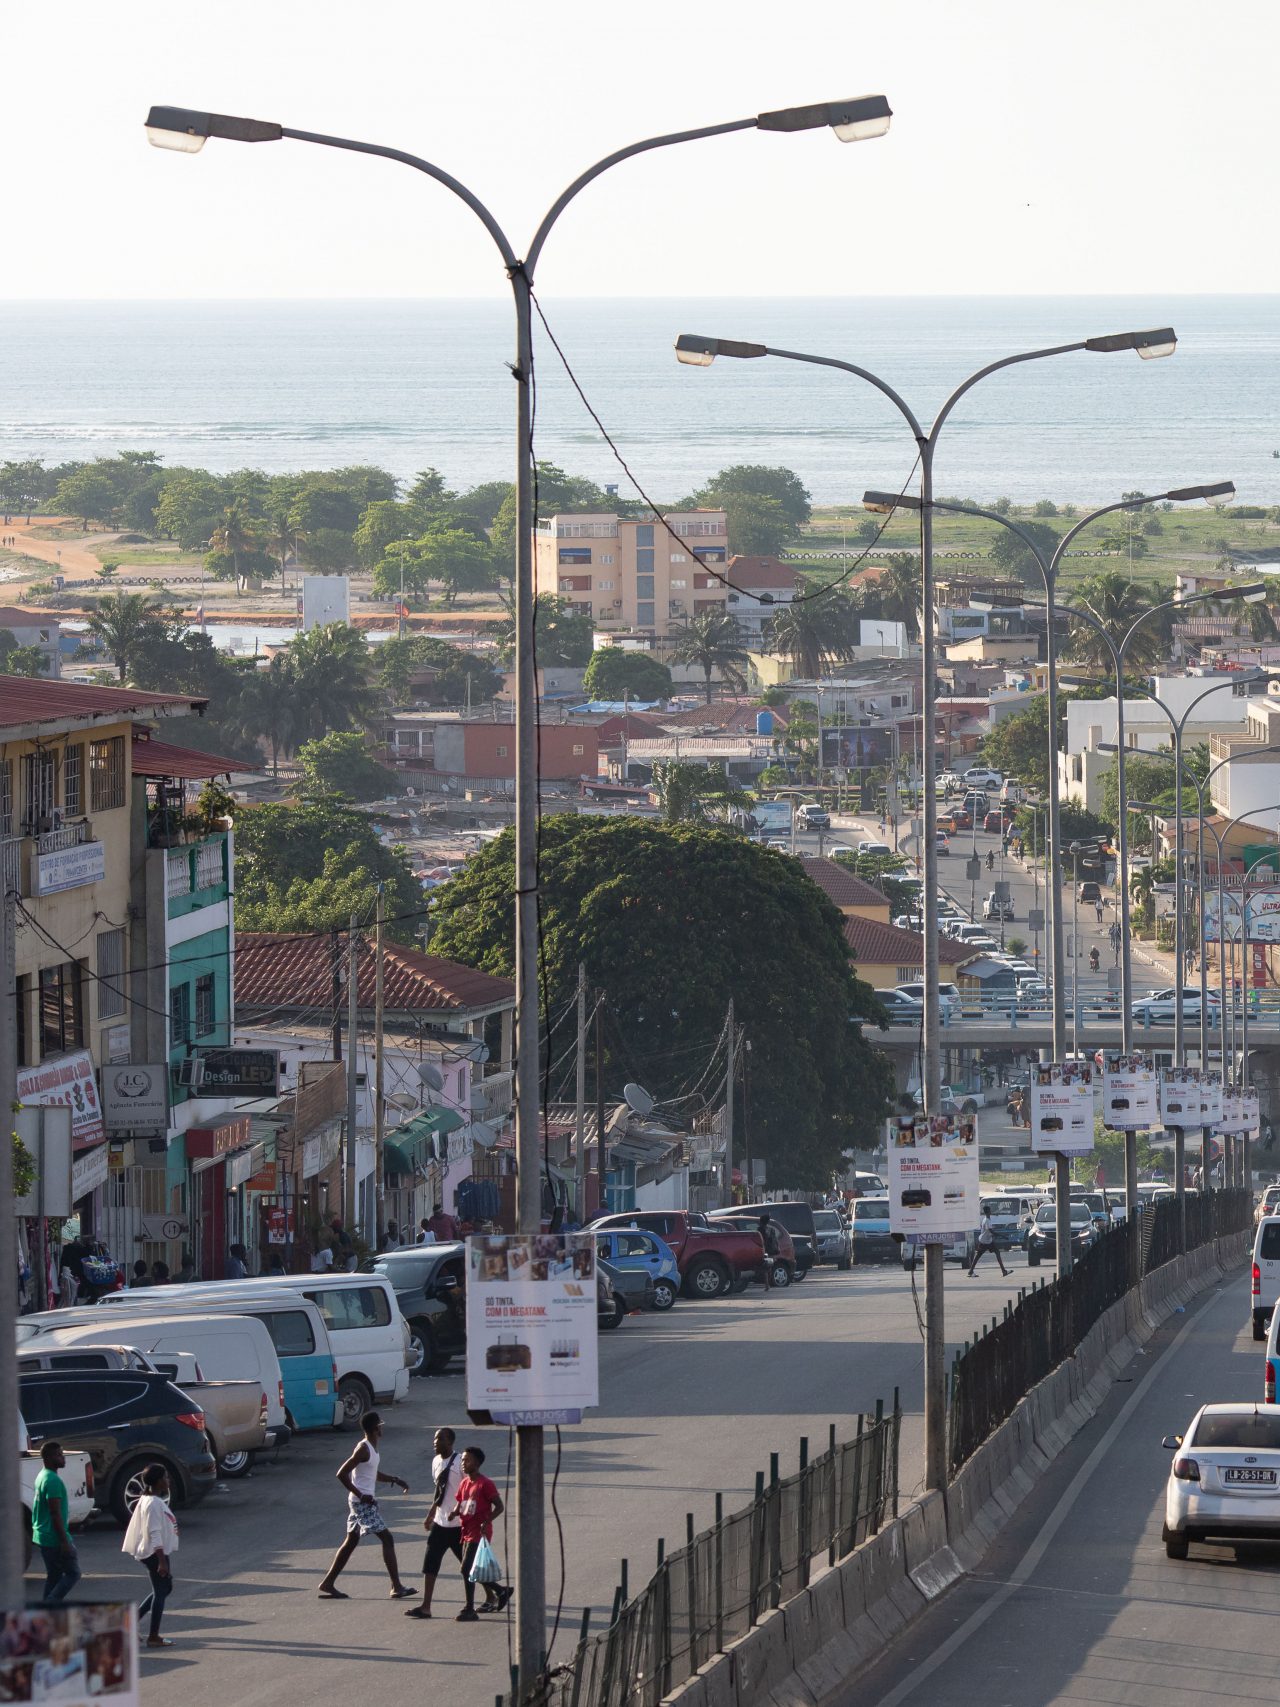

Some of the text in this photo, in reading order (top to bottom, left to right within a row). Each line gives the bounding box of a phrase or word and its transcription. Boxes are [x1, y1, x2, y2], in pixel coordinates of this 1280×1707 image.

[205, 1070, 240, 1083] Design
[242, 1066, 272, 1081] LED
[485, 1307, 502, 1317] COM
